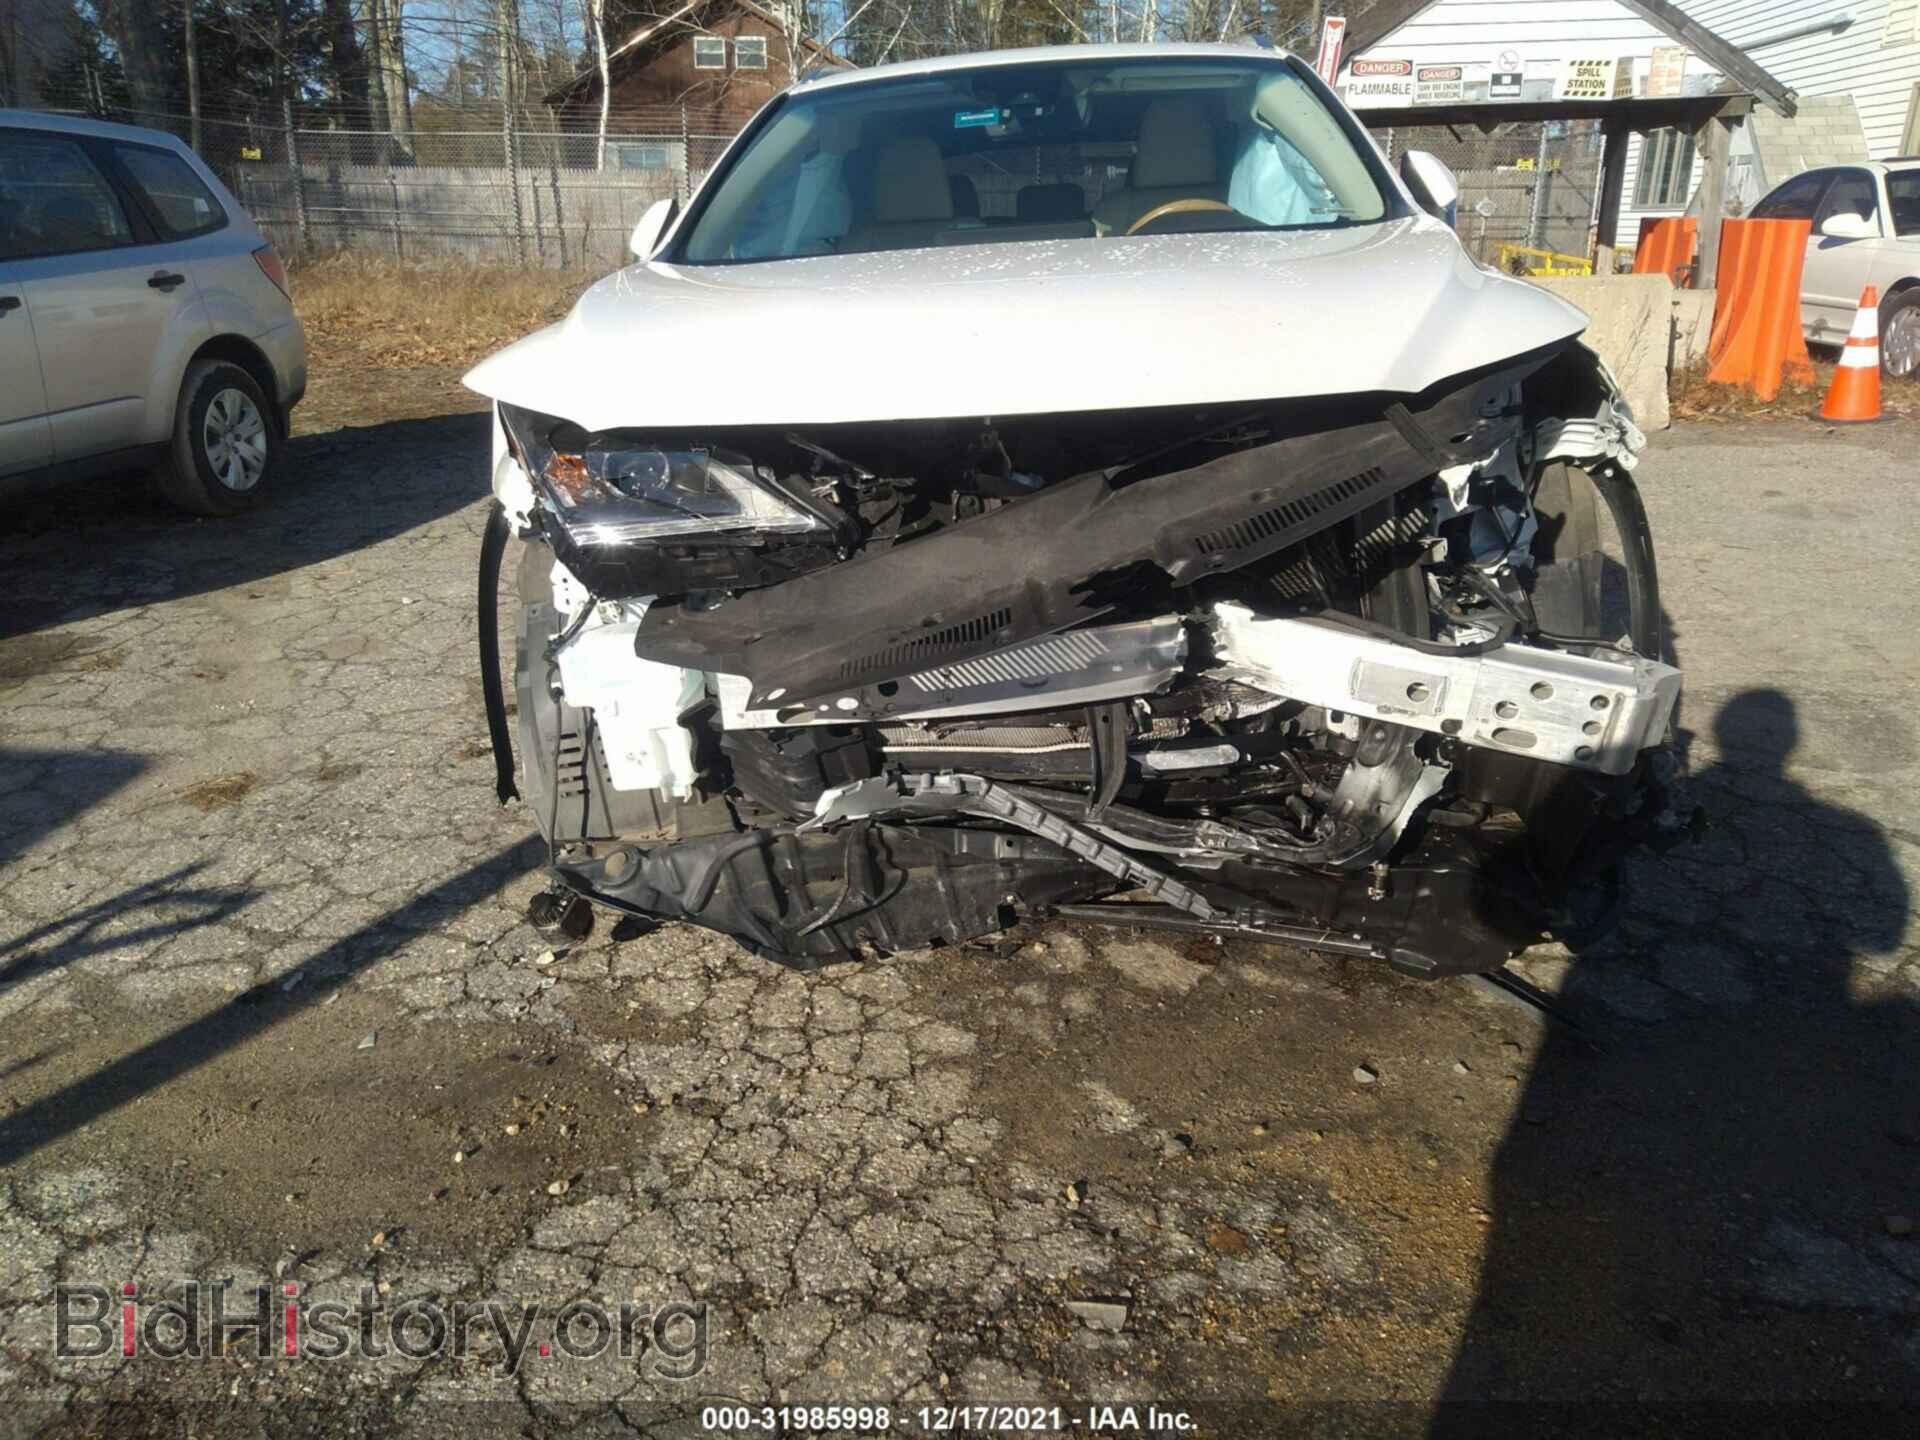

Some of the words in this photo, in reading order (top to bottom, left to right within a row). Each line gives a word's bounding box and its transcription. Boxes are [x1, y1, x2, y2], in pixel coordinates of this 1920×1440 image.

[1359, 63, 1404, 74] DANGER
[1576, 67, 1602, 78] SPILL
[1423, 69, 1457, 80] DANGER
[1348, 83, 1411, 96] FLAMMABLE
[1567, 79, 1606, 89] STATION
